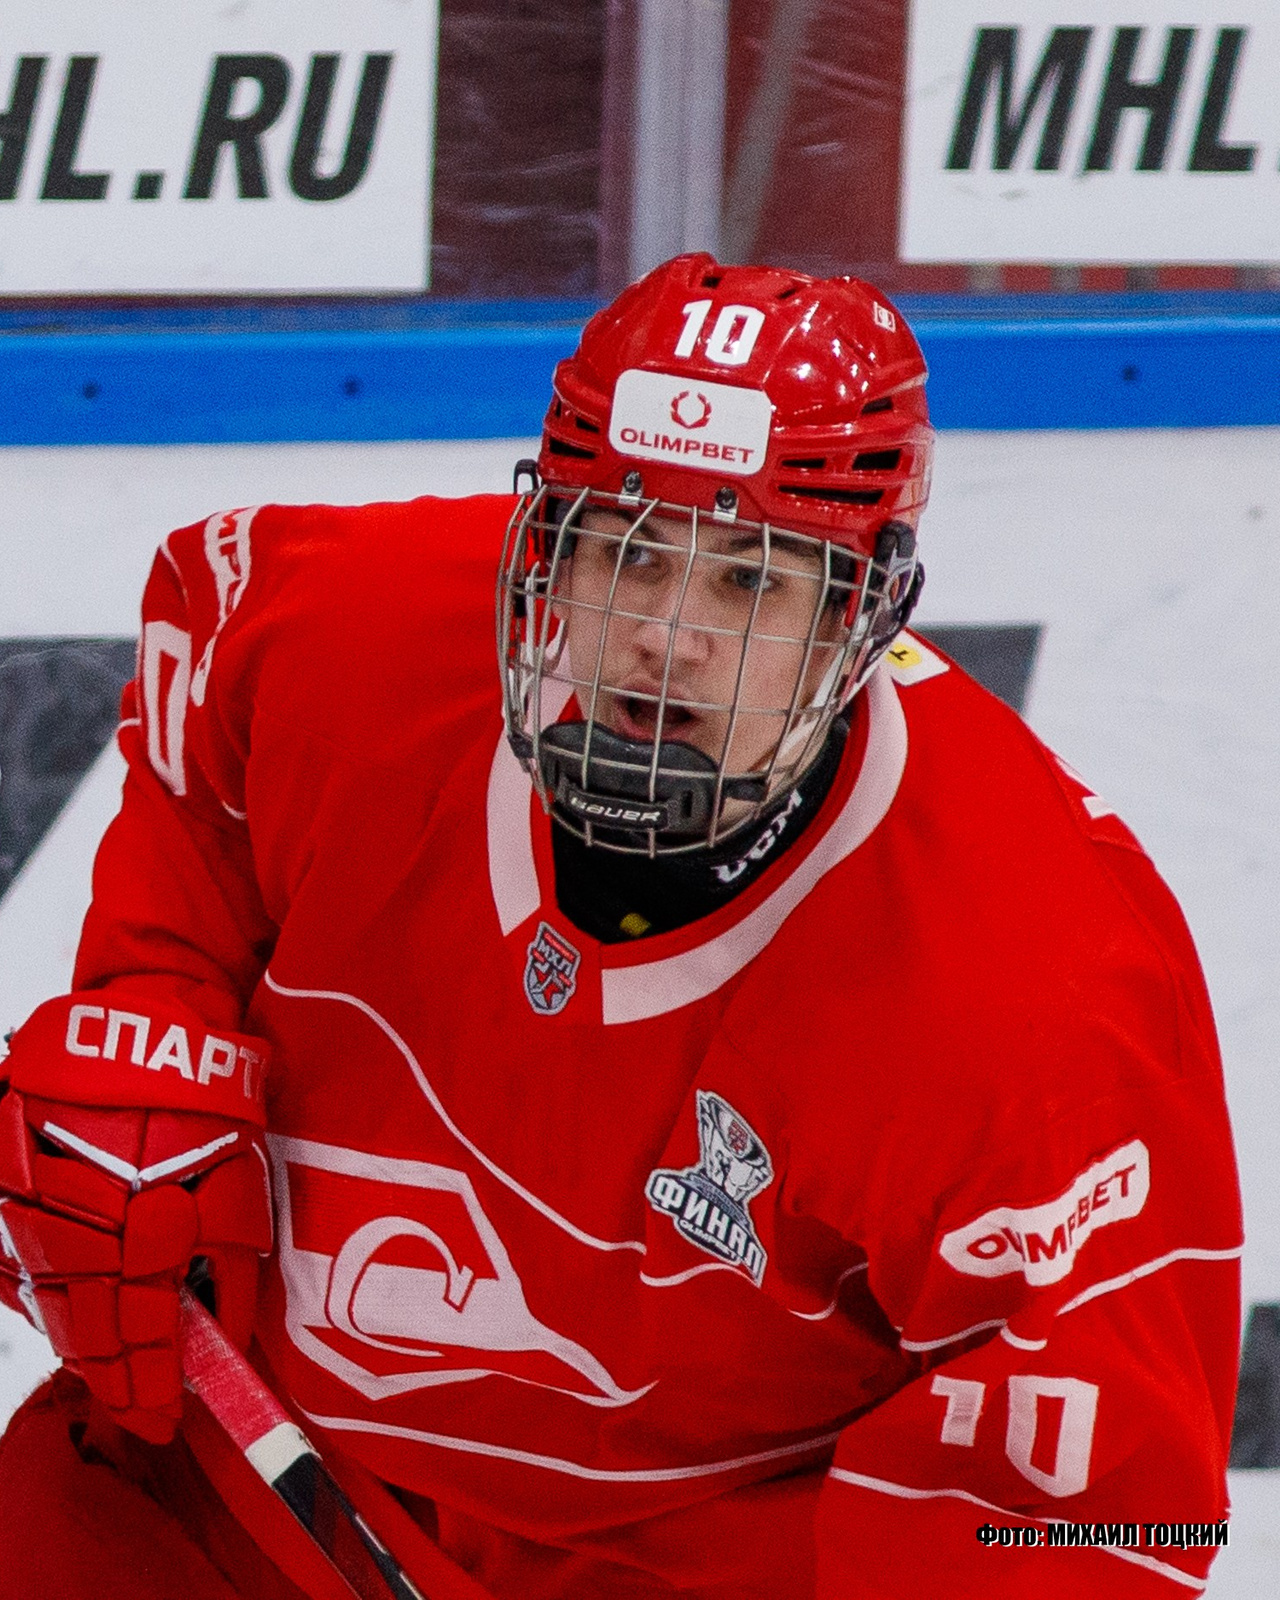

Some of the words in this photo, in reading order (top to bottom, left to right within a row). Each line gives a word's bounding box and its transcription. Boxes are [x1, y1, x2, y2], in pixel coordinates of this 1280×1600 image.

[673, 299, 766, 366] 10
[620, 427, 754, 463] OLIMPBET
[65, 1004, 266, 1100] СПАРТ
[652, 1175, 763, 1276] ФИНАЛ
[930, 1373, 1099, 1498] 10
